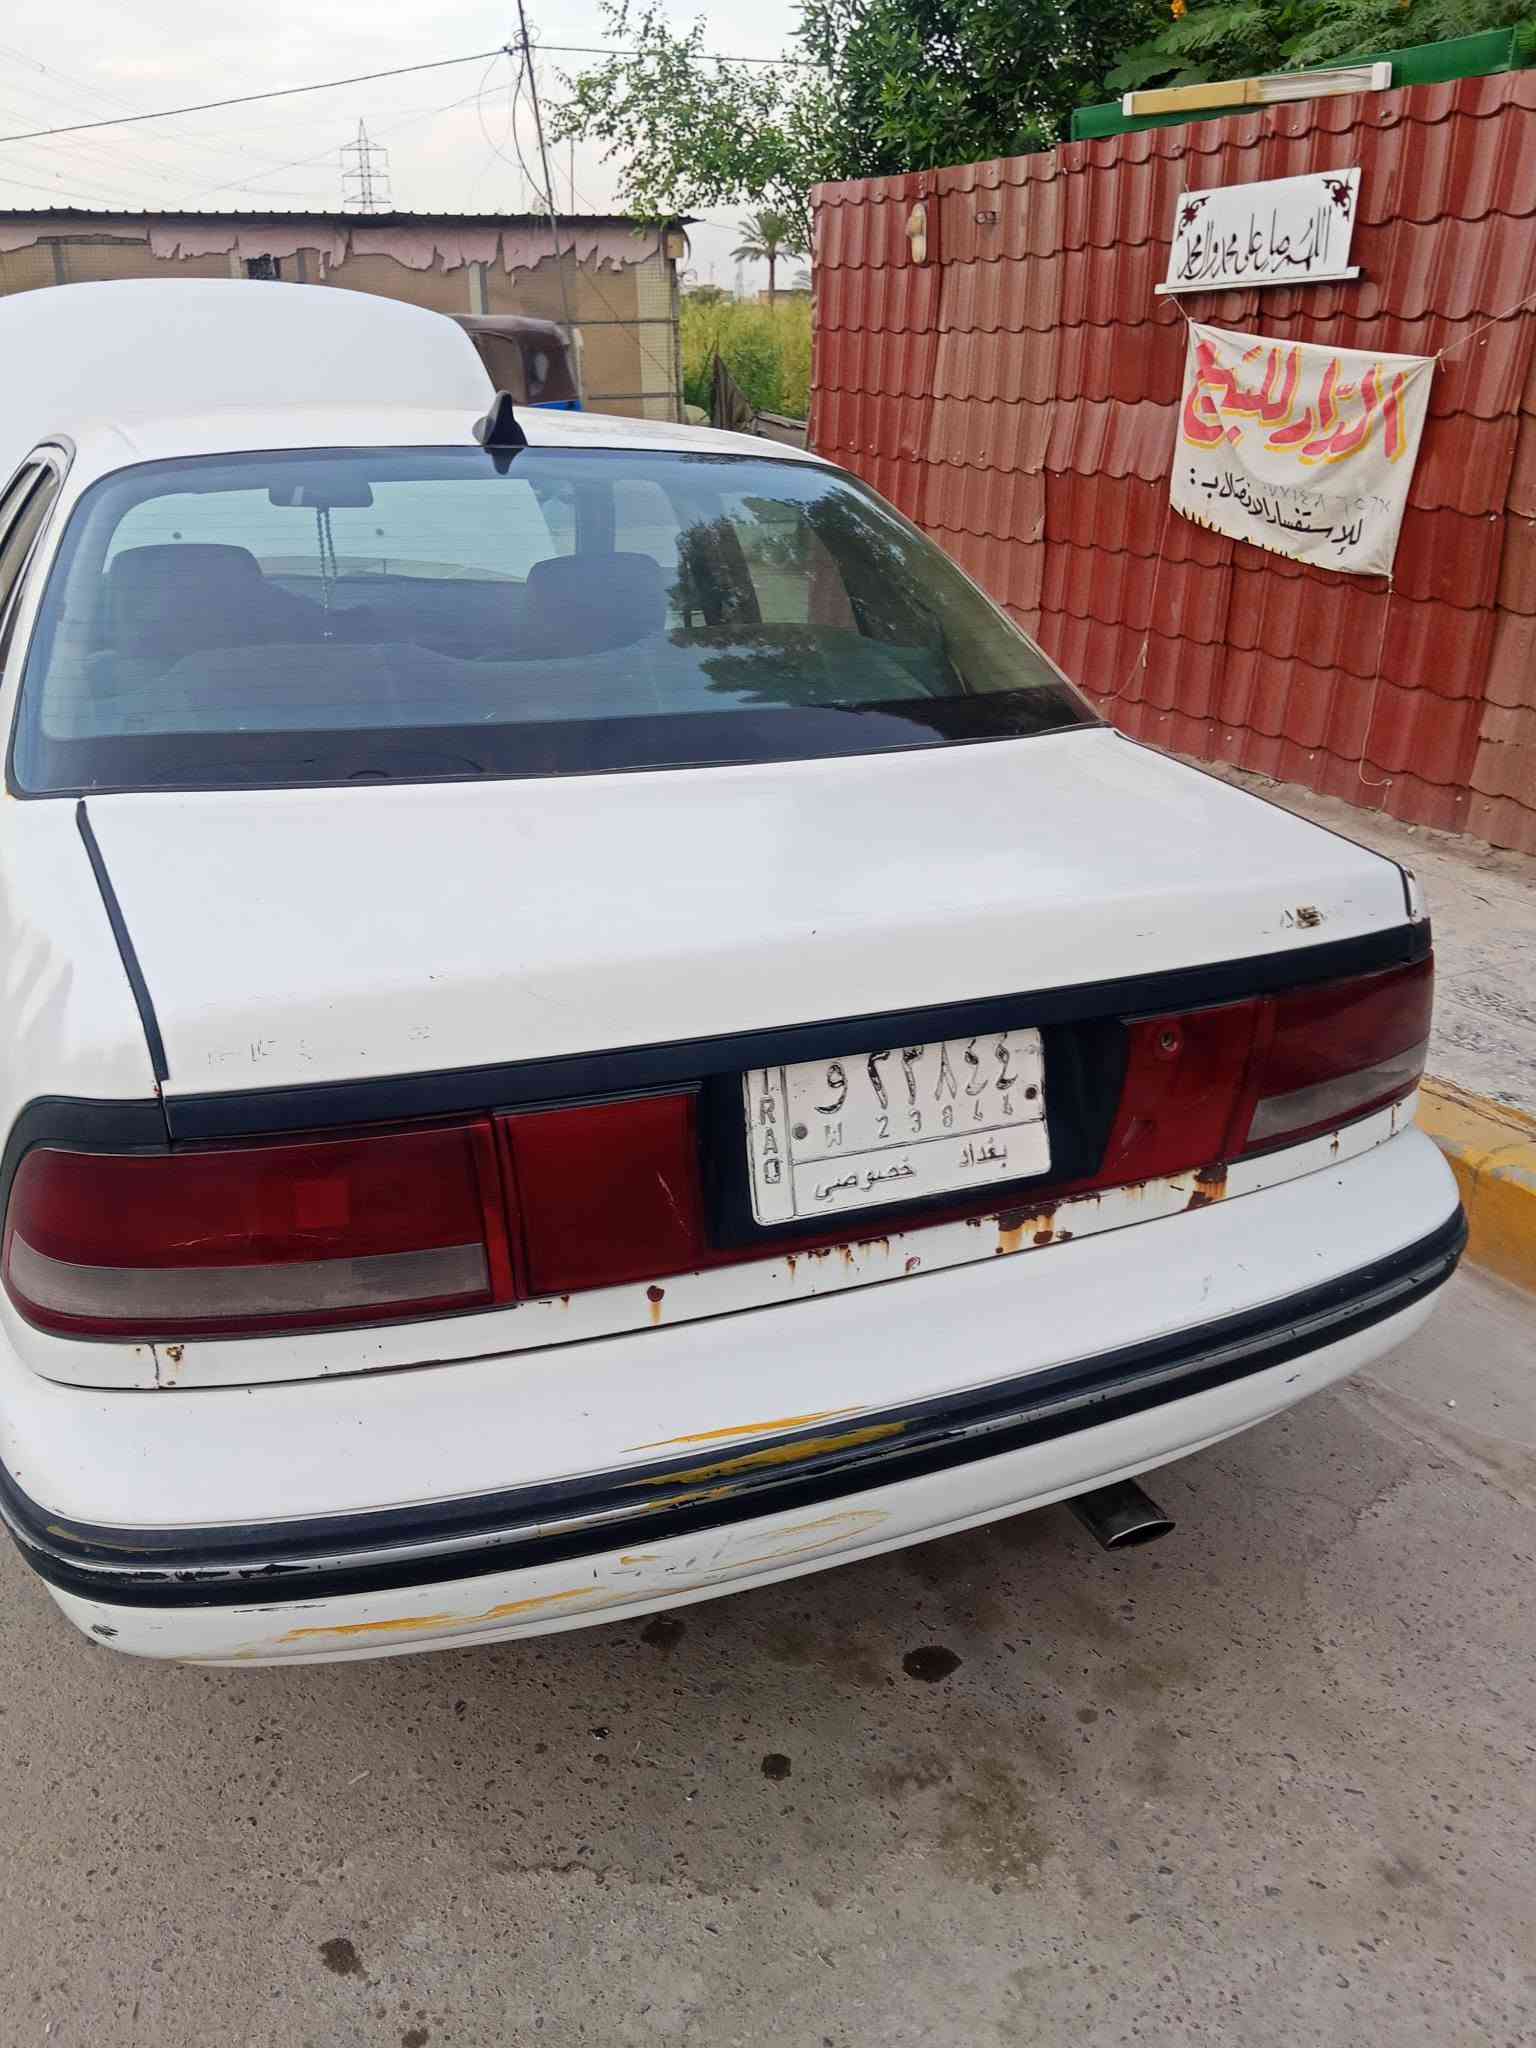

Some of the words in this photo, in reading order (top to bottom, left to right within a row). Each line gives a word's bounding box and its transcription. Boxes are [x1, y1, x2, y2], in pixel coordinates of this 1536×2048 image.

[1183, 339, 1300, 449] للبيع
[759, 1067, 782, 1185] IRAQ
[959, 1137, 1008, 1169] بغداد
[815, 1156, 917, 1202] خصوصي
